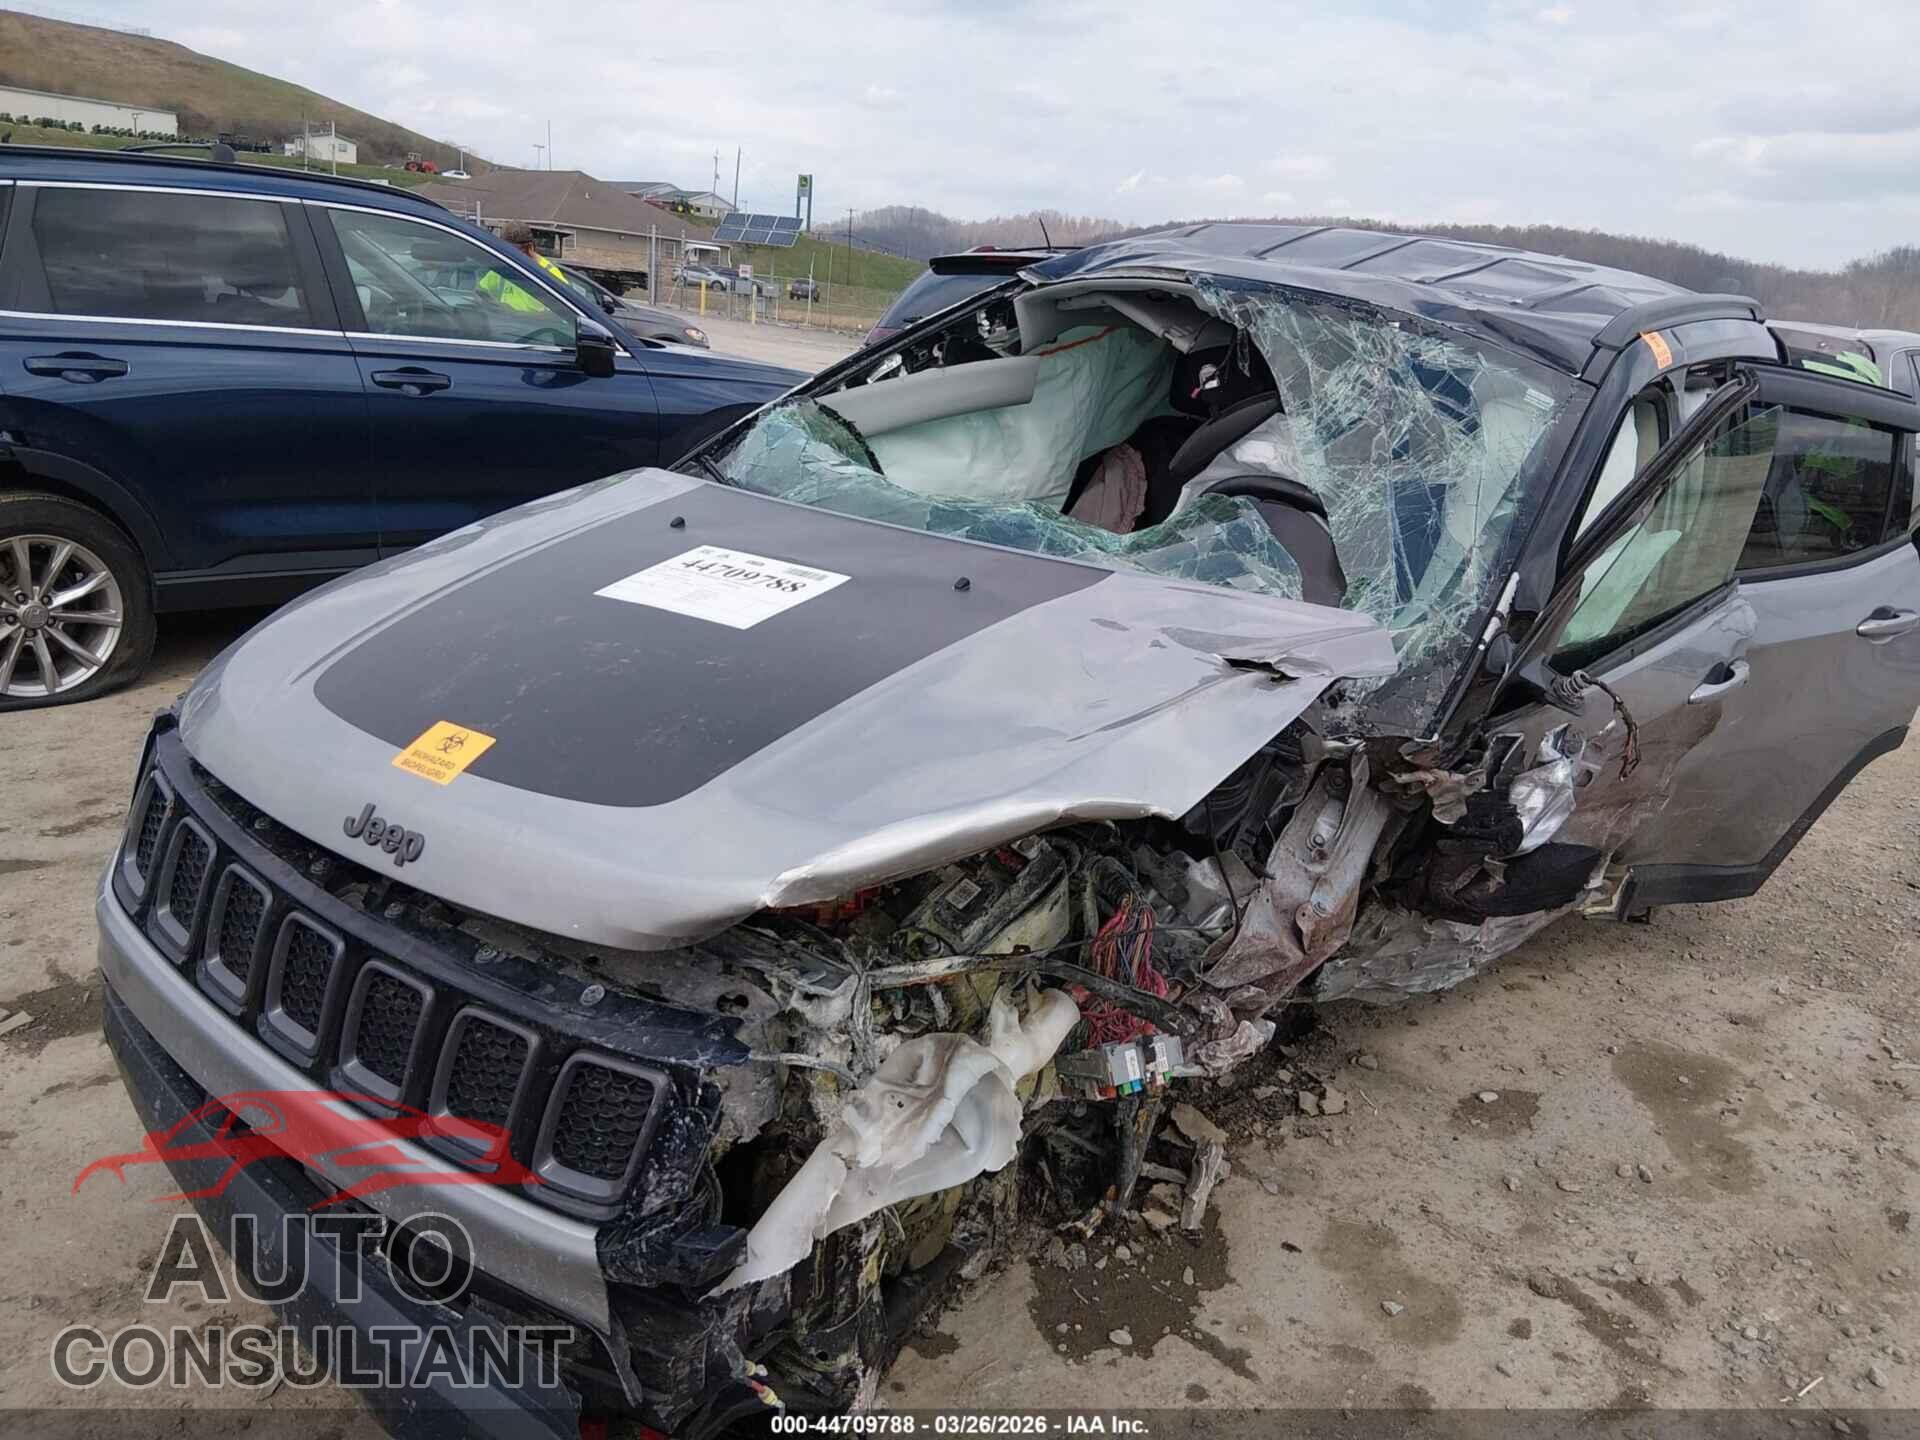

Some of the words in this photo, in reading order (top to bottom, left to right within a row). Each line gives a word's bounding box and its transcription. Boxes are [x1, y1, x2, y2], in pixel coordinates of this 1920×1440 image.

[681, 559, 807, 593] 44709788
[411, 750, 456, 771] BIOHAZARD
[343, 803, 425, 867] Jeep
